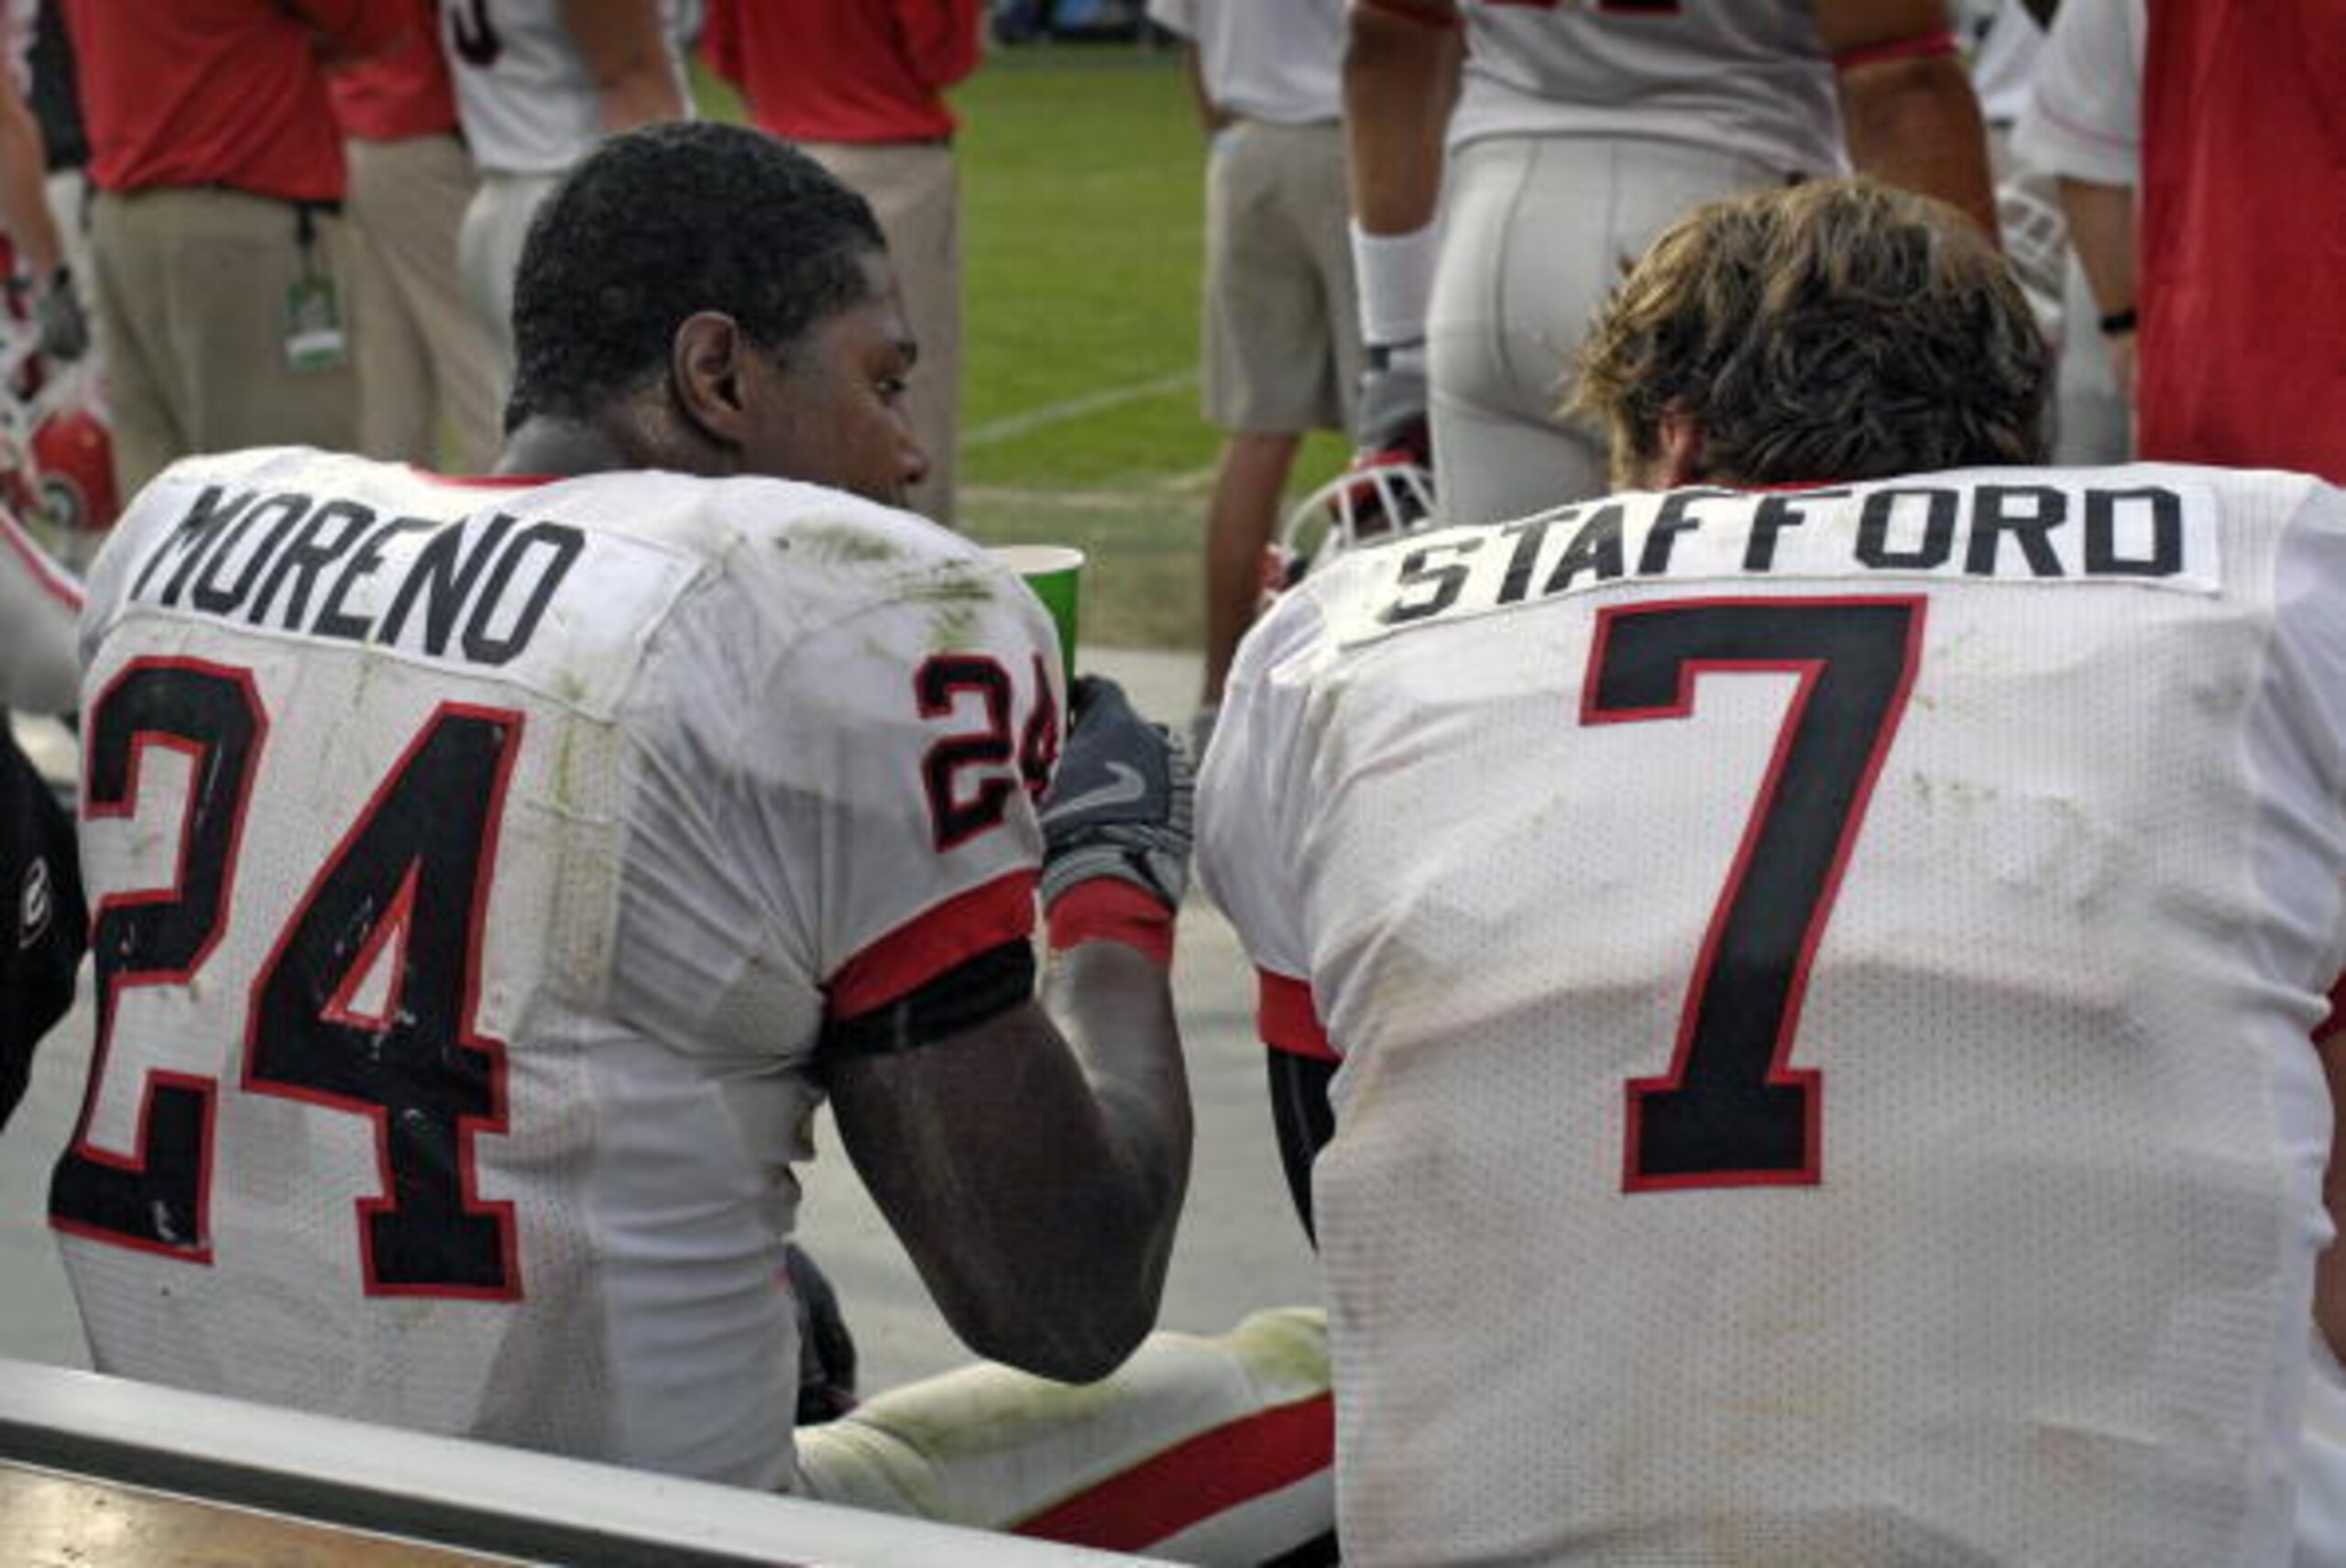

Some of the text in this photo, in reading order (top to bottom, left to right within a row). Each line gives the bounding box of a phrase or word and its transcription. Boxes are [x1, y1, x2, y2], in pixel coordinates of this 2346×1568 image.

[131, 485, 585, 666] MORENO
[1380, 484, 2184, 626] STAFFORD
[49, 655, 524, 1300] 24
[1579, 594, 1928, 1194] 7
